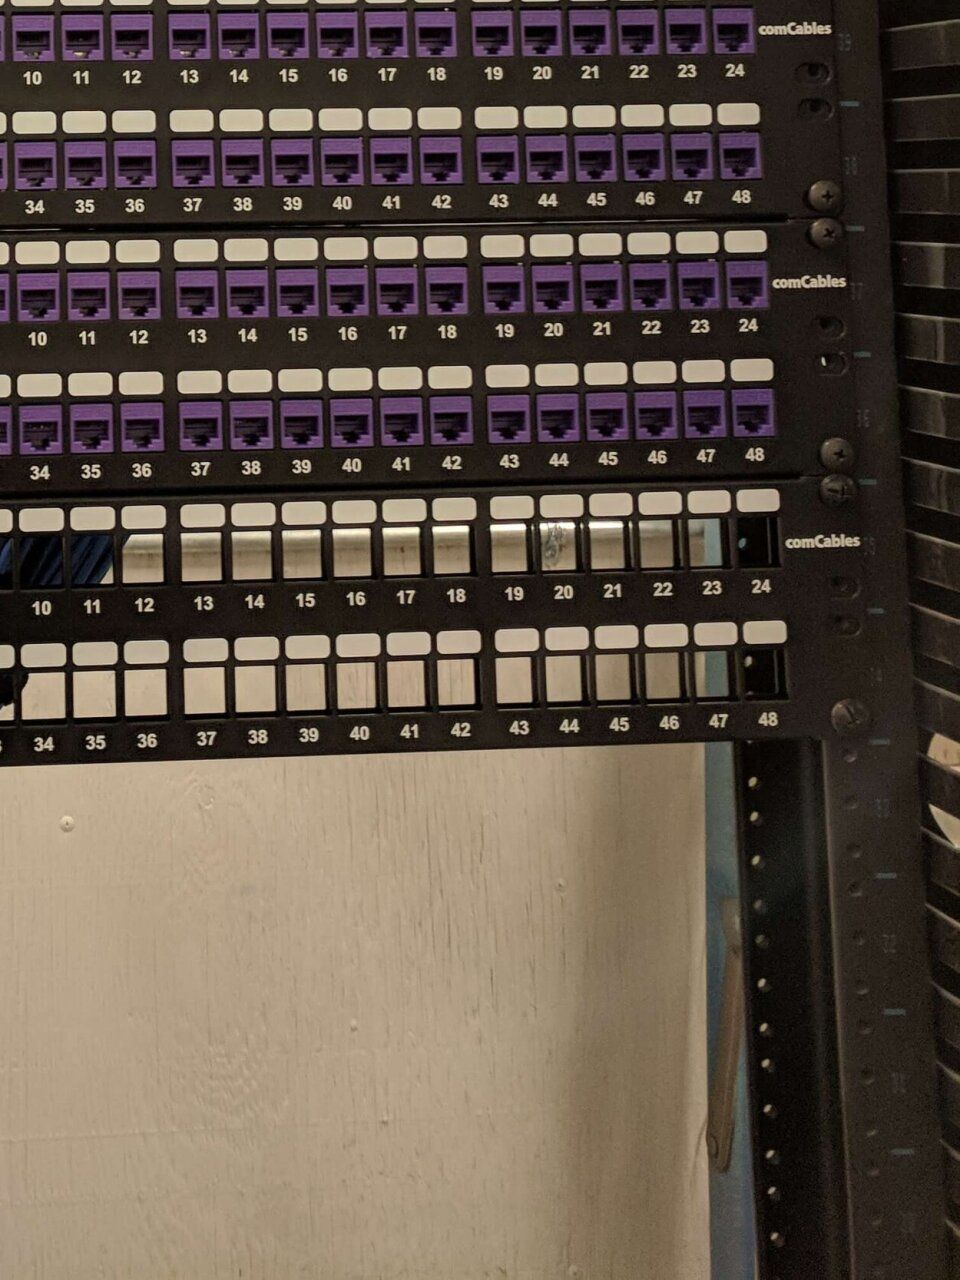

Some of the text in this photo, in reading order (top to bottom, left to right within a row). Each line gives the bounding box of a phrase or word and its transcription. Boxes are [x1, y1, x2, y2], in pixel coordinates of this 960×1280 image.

[758, 22, 832, 35] comCables
[23, 70, 43, 86] 10
[72, 70, 90, 85] 11
[122, 69, 142, 84] 12
[179, 69, 200, 84] 13
[229, 68, 250, 83] 14
[278, 68, 299, 83] 15
[328, 67, 348, 83] 16
[377, 67, 398, 82] 17
[426, 67, 447, 81] 18
[484, 66, 504, 81] 19
[532, 65, 552, 80] 20
[580, 65, 600, 80] 21
[629, 64, 650, 79] 22
[677, 63, 698, 78] 23
[725, 63, 746, 78] 24
[24, 199, 46, 215] 34
[74, 199, 96, 214] 35
[125, 198, 146, 213] 36
[183, 197, 203, 212] 37
[233, 196, 253, 212] 38
[282, 196, 303, 211] 39
[332, 195, 353, 211] 40
[381, 195, 401, 210] 41
[431, 194, 452, 209] 42
[488, 193, 509, 208] 43
[537, 193, 559, 207] 44
[586, 192, 607, 207] 45
[635, 191, 656, 206] 46
[683, 190, 703, 205] 47
[731, 189, 752, 204] 48
[772, 274, 847, 288] comCables
[28, 331, 48, 347] 10
[78, 330, 96, 346] 11
[129, 329, 149, 345] 12
[187, 328, 208, 344] 13
[237, 327, 258, 343] 14
[288, 327, 308, 342] 15
[338, 326, 358, 341] 16
[388, 325, 408, 340] 17
[437, 324, 458, 339] 18
[495, 323, 515, 338] 19
[543, 322, 564, 337] 20
[592, 321, 611, 336] 21
[641, 320, 662, 335] 22
[690, 319, 710, 334] 23
[738, 318, 759, 333] 24
[29, 465, 51, 481] 34
[81, 464, 102, 479] 35
[131, 462, 152, 478] 36
[190, 461, 211, 477] 37
[241, 460, 262, 475] 38
[291, 459, 312, 474] 39
[341, 457, 362, 473] 40
[391, 456, 411, 472] 41
[441, 455, 462, 470] 42
[499, 454, 520, 469] 43
[548, 452, 570, 467] 44
[598, 451, 619, 466] 45
[647, 450, 668, 465] 46
[696, 448, 716, 463] 47
[745, 447, 765, 462] 48
[785, 534, 861, 549] comCables
[31, 600, 52, 616] 10
[83, 598, 101, 614] 11
[134, 597, 155, 613] 12
[194, 595, 214, 611] 13
[244, 594, 265, 609] 14
[295, 592, 316, 608] 15
[346, 591, 366, 606] 16
[396, 589, 416, 605] 17
[446, 588, 466, 603] 18
[504, 586, 524, 601] 19
[554, 584, 574, 600] 20
[603, 583, 622, 599] 21
[653, 581, 673, 597] 22
[702, 580, 722, 595] 23
[751, 578, 772, 594] 24
[33, 736, 55, 752] 34
[85, 734, 106, 750] 35
[137, 733, 158, 749] 36
[196, 731, 217, 747] 37
[248, 729, 269, 745] 38
[299, 727, 320, 743] 39
[349, 725, 370, 741] 40
[399, 723, 419, 739] 41
[450, 722, 471, 737] 42
[509, 720, 530, 735] 43
[559, 718, 580, 734] 44
[609, 716, 630, 732] 45
[659, 715, 680, 730] 46
[708, 713, 729, 728] 47
[758, 711, 778, 727] 48
